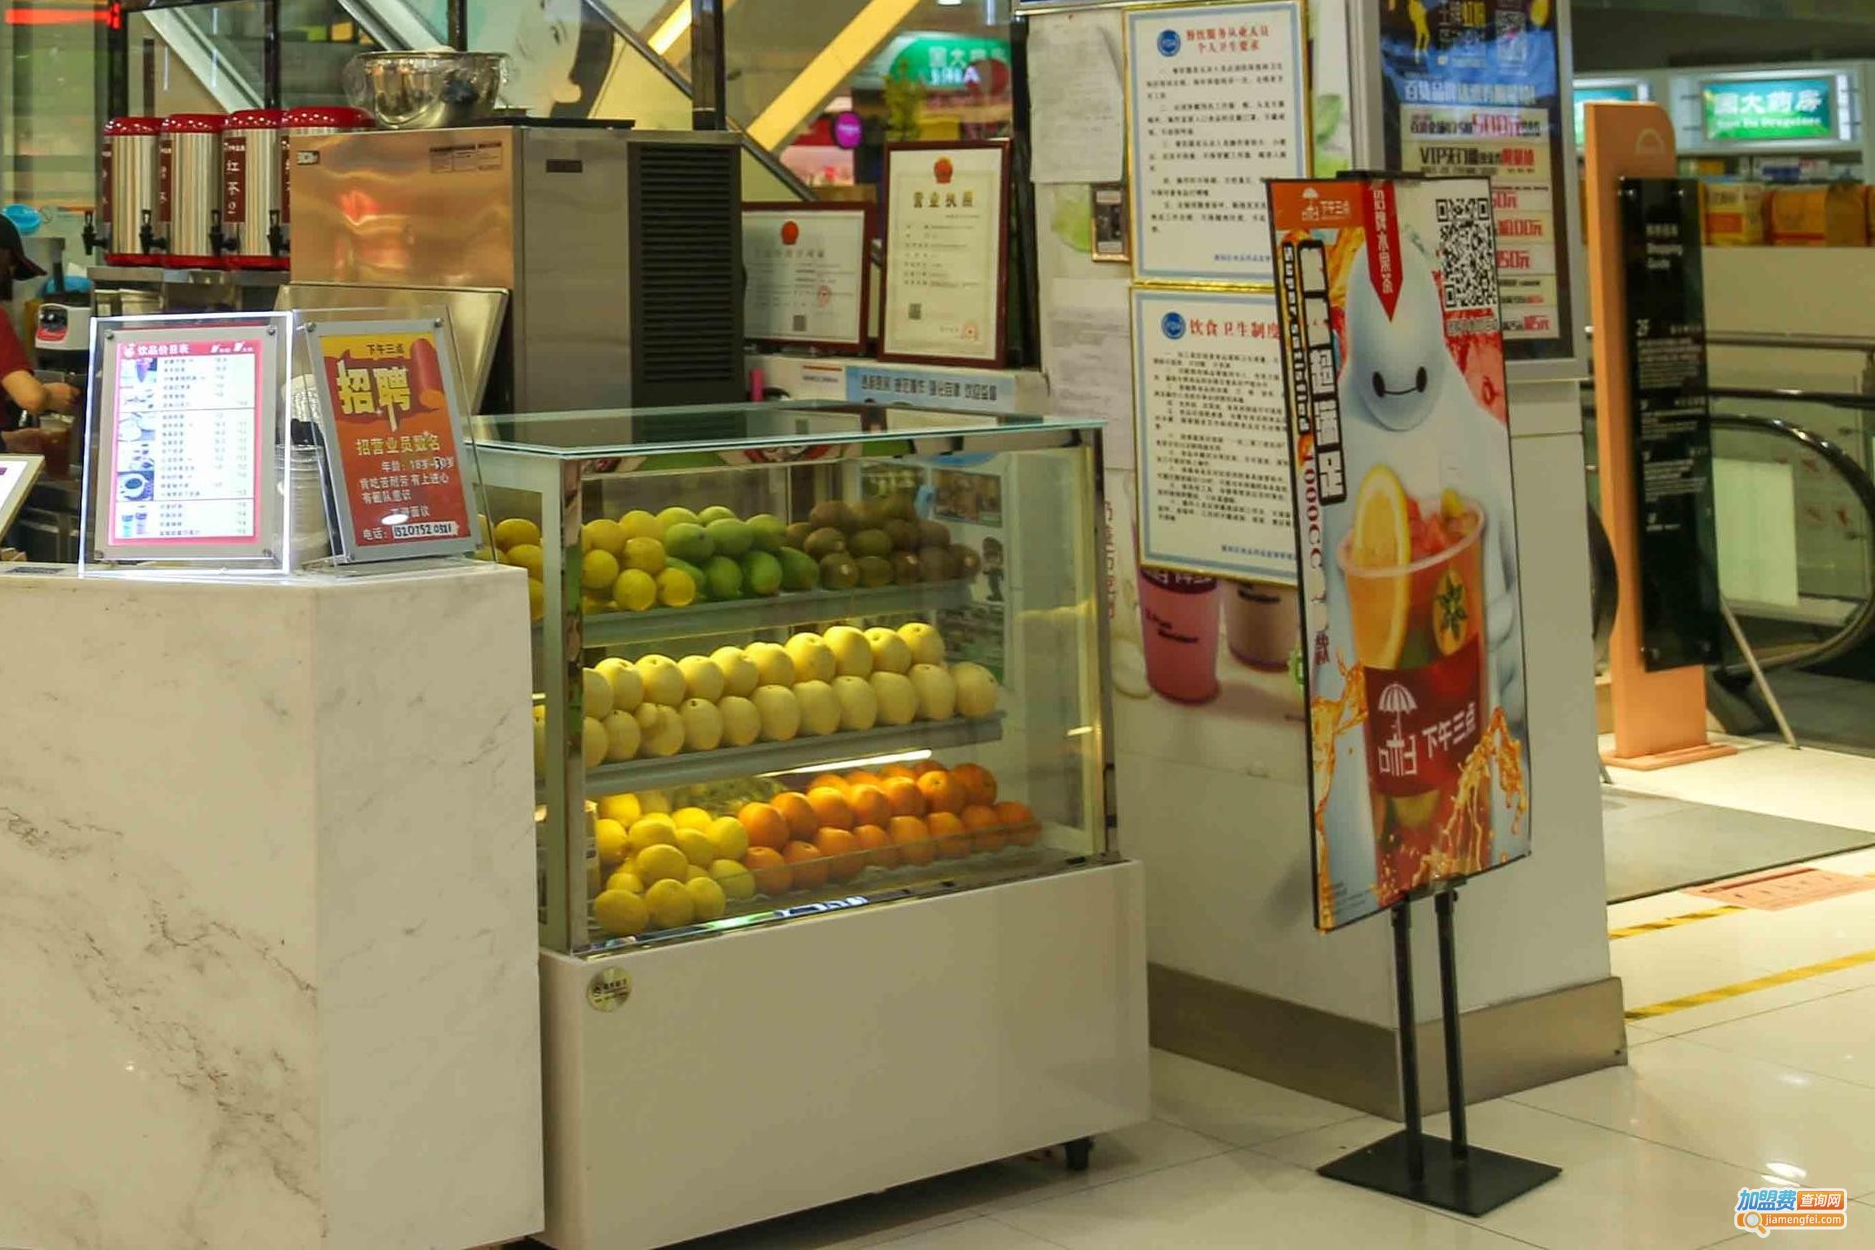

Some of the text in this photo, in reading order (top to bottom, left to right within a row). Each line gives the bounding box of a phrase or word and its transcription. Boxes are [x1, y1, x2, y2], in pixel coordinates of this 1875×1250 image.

[913, 191, 974, 208] 营业执照
[366, 343, 405, 355] 下午三点
[335, 358, 412, 432] 招聘
[1421, 701, 1476, 760] 下午三点
